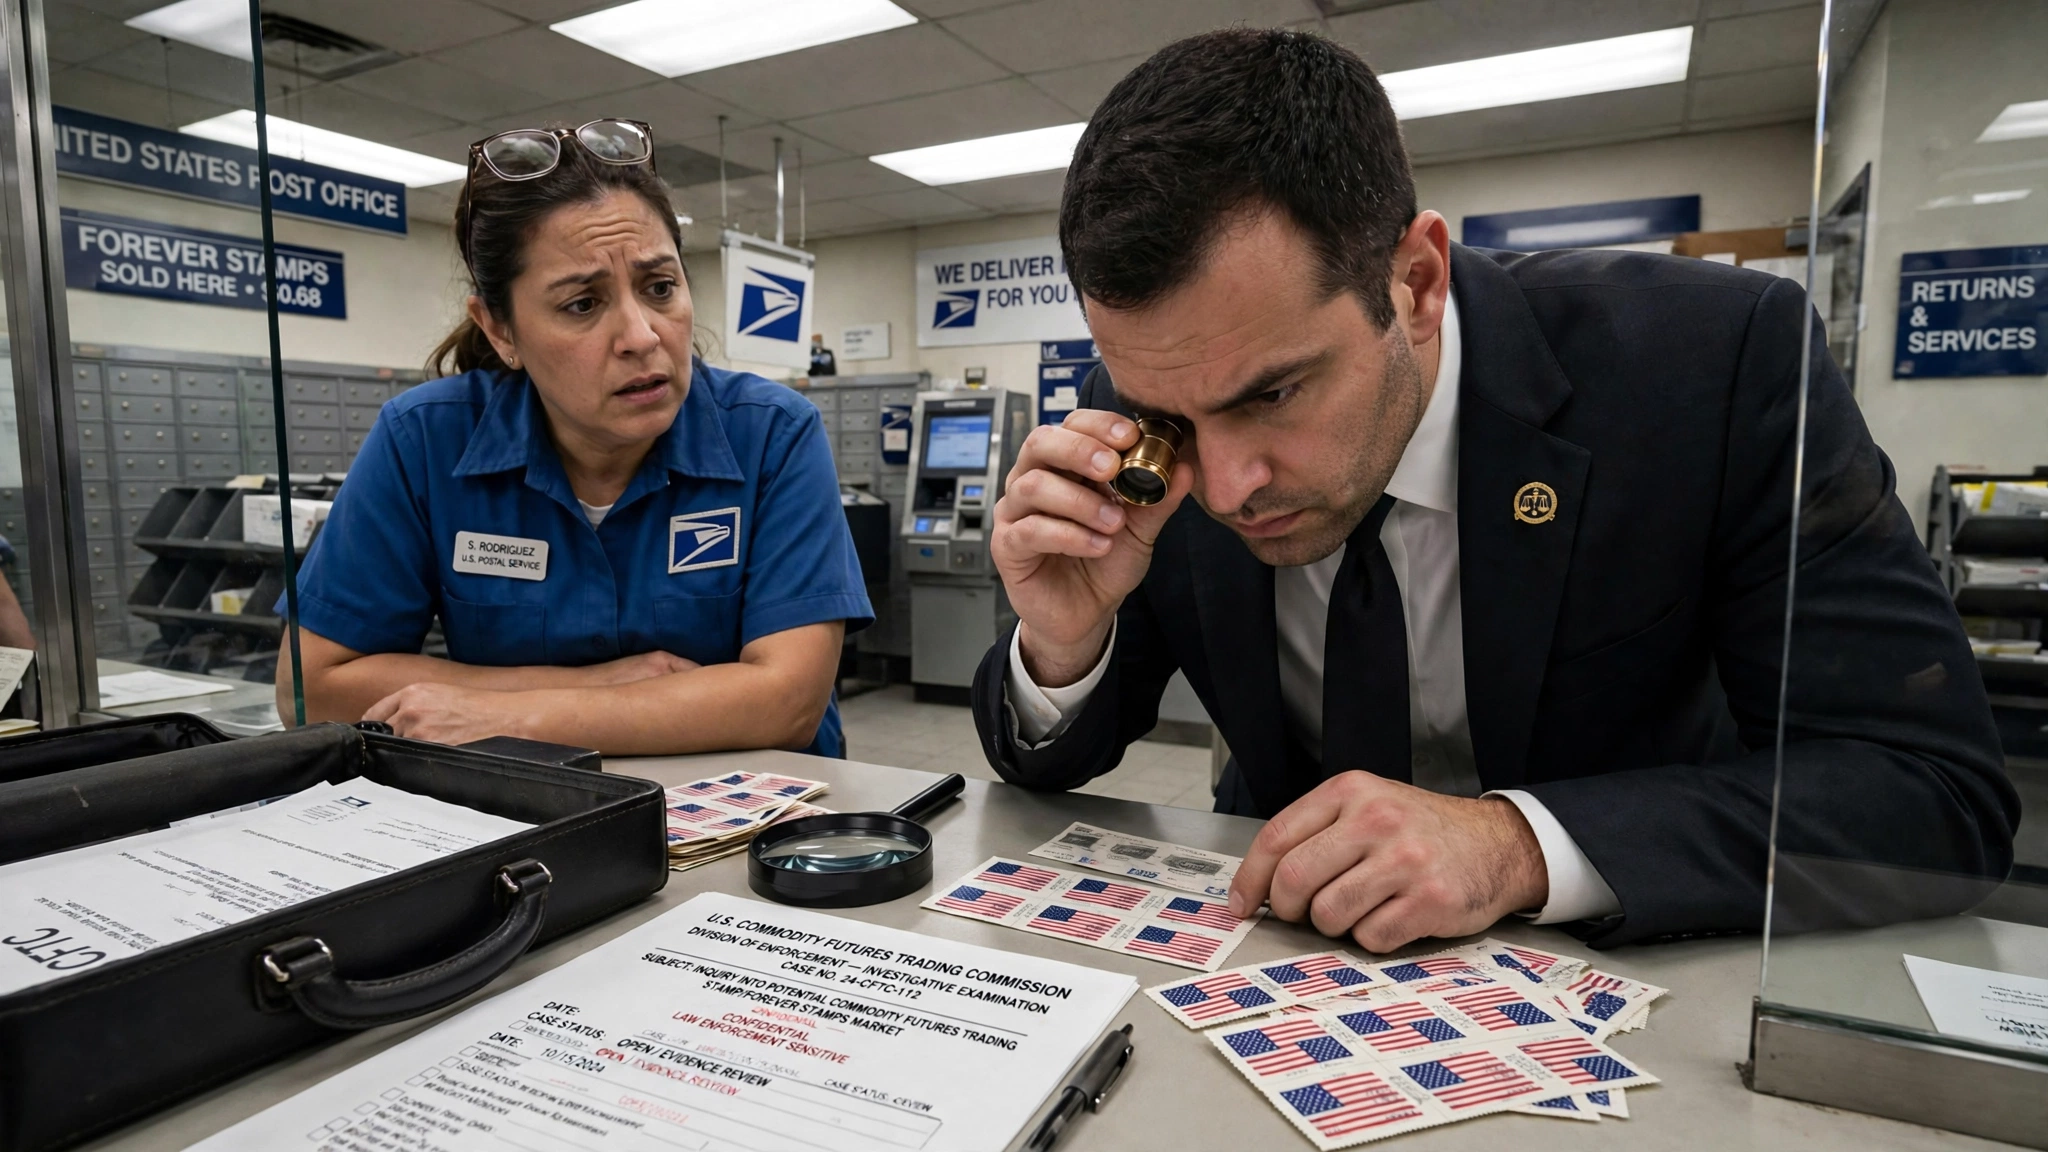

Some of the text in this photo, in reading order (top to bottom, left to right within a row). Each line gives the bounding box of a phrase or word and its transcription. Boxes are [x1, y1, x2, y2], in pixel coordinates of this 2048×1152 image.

[140, 141, 242, 187] STATES
[248, 164, 316, 201] POST
[320, 181, 399, 218] OFFICE
[78, 225, 219, 270] FOREVER
[101, 260, 170, 289] SOLD
[177, 270, 238, 297] HERE
[934, 263, 965, 285] WE
[971, 255, 1054, 283] DELIVER
[987, 286, 1024, 309] FOR
[1029, 284, 1068, 305] YOU
[1911, 275, 2036, 303] RETURNS
[1909, 305, 1929, 328] &
[1908, 327, 2037, 354] SERVICES
[461, 553, 476, 564] U.S.
[478, 556, 506, 567] POSTAL
[467, 540, 536, 557] S. RODRIGUEZ
[1, 928, 107, 970] CFTC
[706, 913, 1073, 1000] U.S. COMMODITY FUTURES TRADING COMMISSION
[687, 926, 740, 945] DIVISION
[739, 938, 760, 948] OF
[757, 943, 850, 969] ENFORCEMENT
[861, 964, 957, 993] INVESTIGATIVE
[956, 986, 1051, 1015] EXAMINATION
[780, 961, 922, 1000] CASE NO. 24-CFTC-112
[543, 1001, 581, 1016] DATE:
[641, 952, 695, 971] SUBJECT:
[692, 965, 739, 982] INQUIRY
[737, 975, 767, 990] INTO
[766, 982, 827, 1005] POTENTIAL
[828, 997, 904, 1023] COMMODITY
[903, 1015, 961, 1037] FUTURES
[961, 1029, 1018, 1051] TRADING
[702, 980, 801, 1012] STAMP/FOREVER
[799, 1004, 850, 1025] STAMPS
[849, 1017, 905, 1038] MARKET
[489, 1031, 524, 1048] DATE:
[556, 1019, 607, 1041] STATUS:
[672, 1011, 702, 1026] LAW
[699, 1018, 788, 1047] ENFORCEMENT
[785, 1041, 851, 1065] SENSITIVE
[721, 1012, 811, 1042] CONFIDENTIAL
[617, 1038, 655, 1055] OPEN
[658, 1049, 723, 1075] EVIDENCE
[719, 1066, 773, 1088] REVIEW
